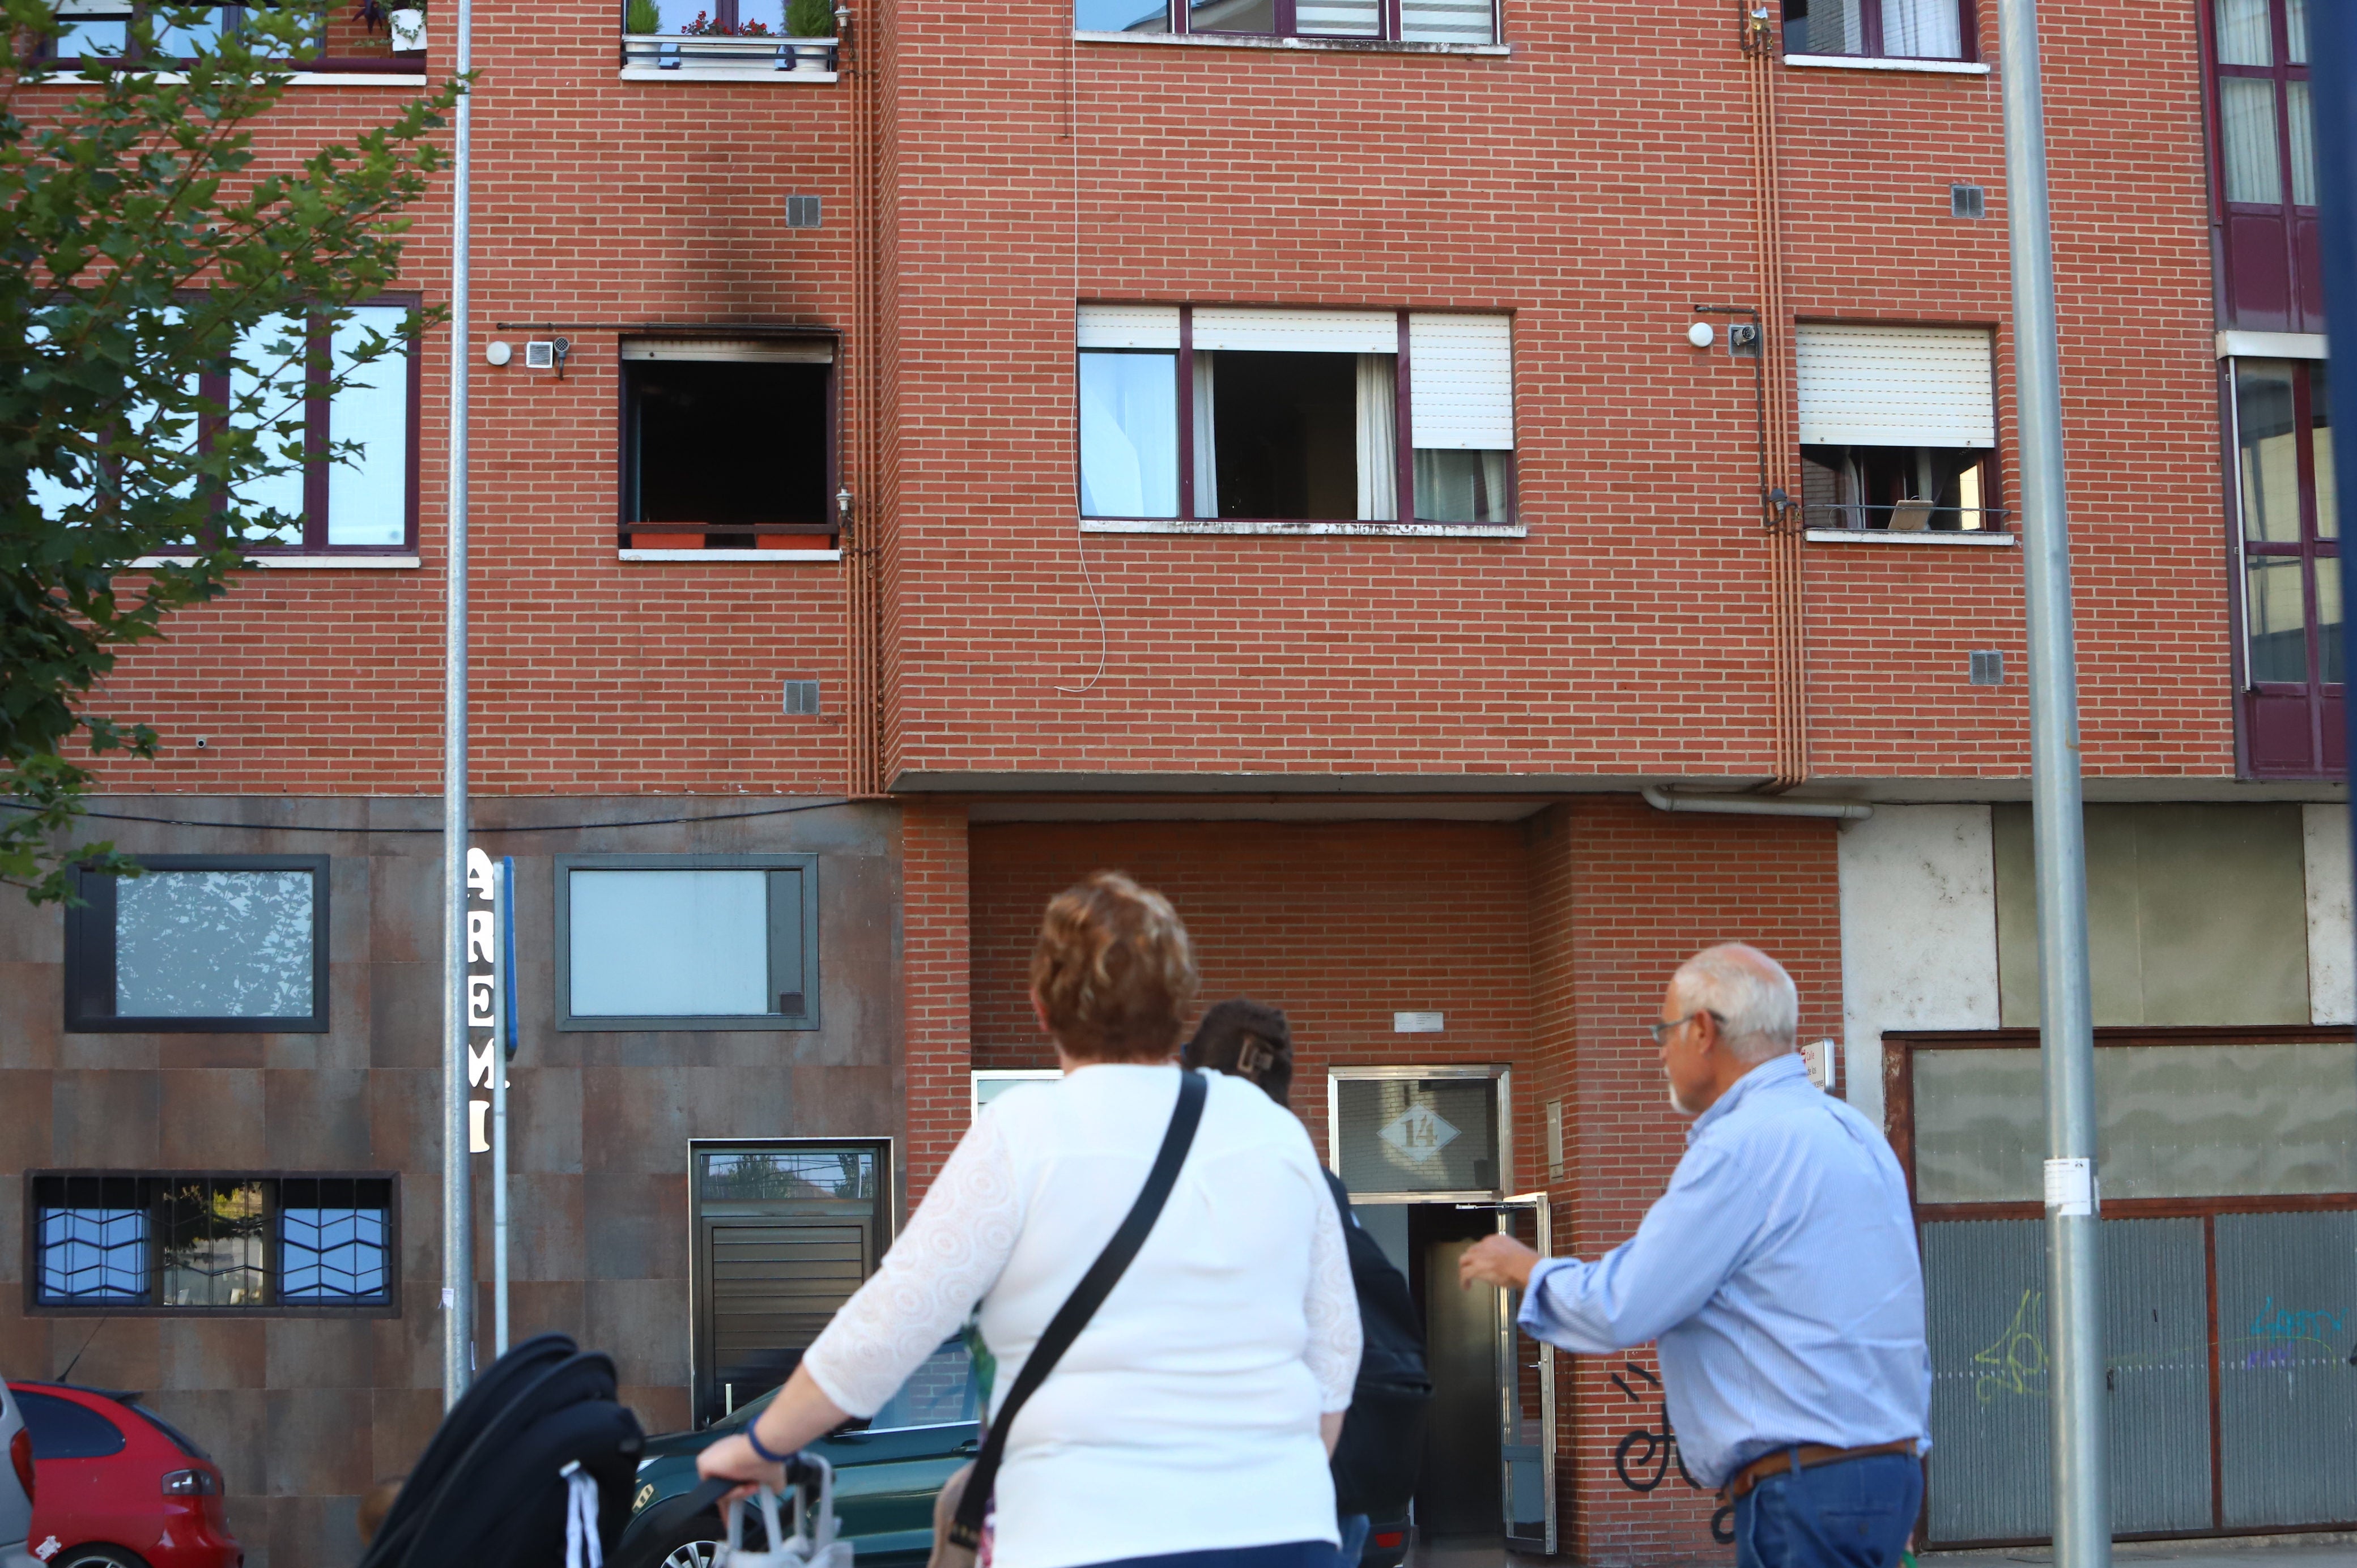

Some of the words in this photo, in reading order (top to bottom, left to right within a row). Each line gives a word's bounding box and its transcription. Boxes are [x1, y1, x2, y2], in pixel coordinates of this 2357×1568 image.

[1806, 1051, 1815, 1061] Calle
[1807, 1067, 1811, 1076] de
[1400, 1114, 1439, 1148] 14
